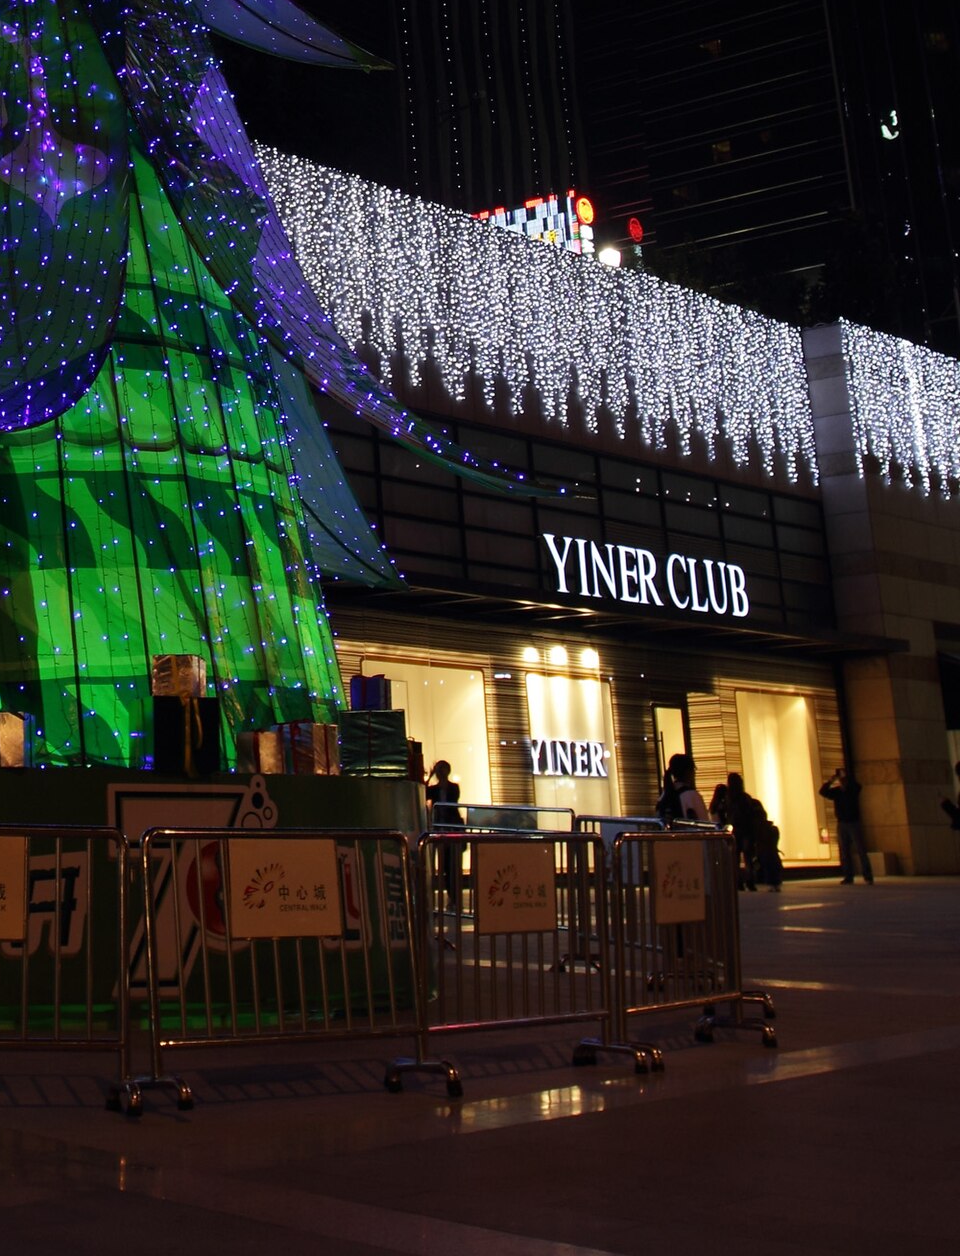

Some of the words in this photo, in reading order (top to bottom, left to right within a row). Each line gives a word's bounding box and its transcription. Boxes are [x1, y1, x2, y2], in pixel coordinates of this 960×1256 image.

[542, 533, 665, 606] YINER
[666, 553, 750, 618] CLUB
[530, 739, 608, 777] YINER
[278, 885, 326, 901] 中心城
